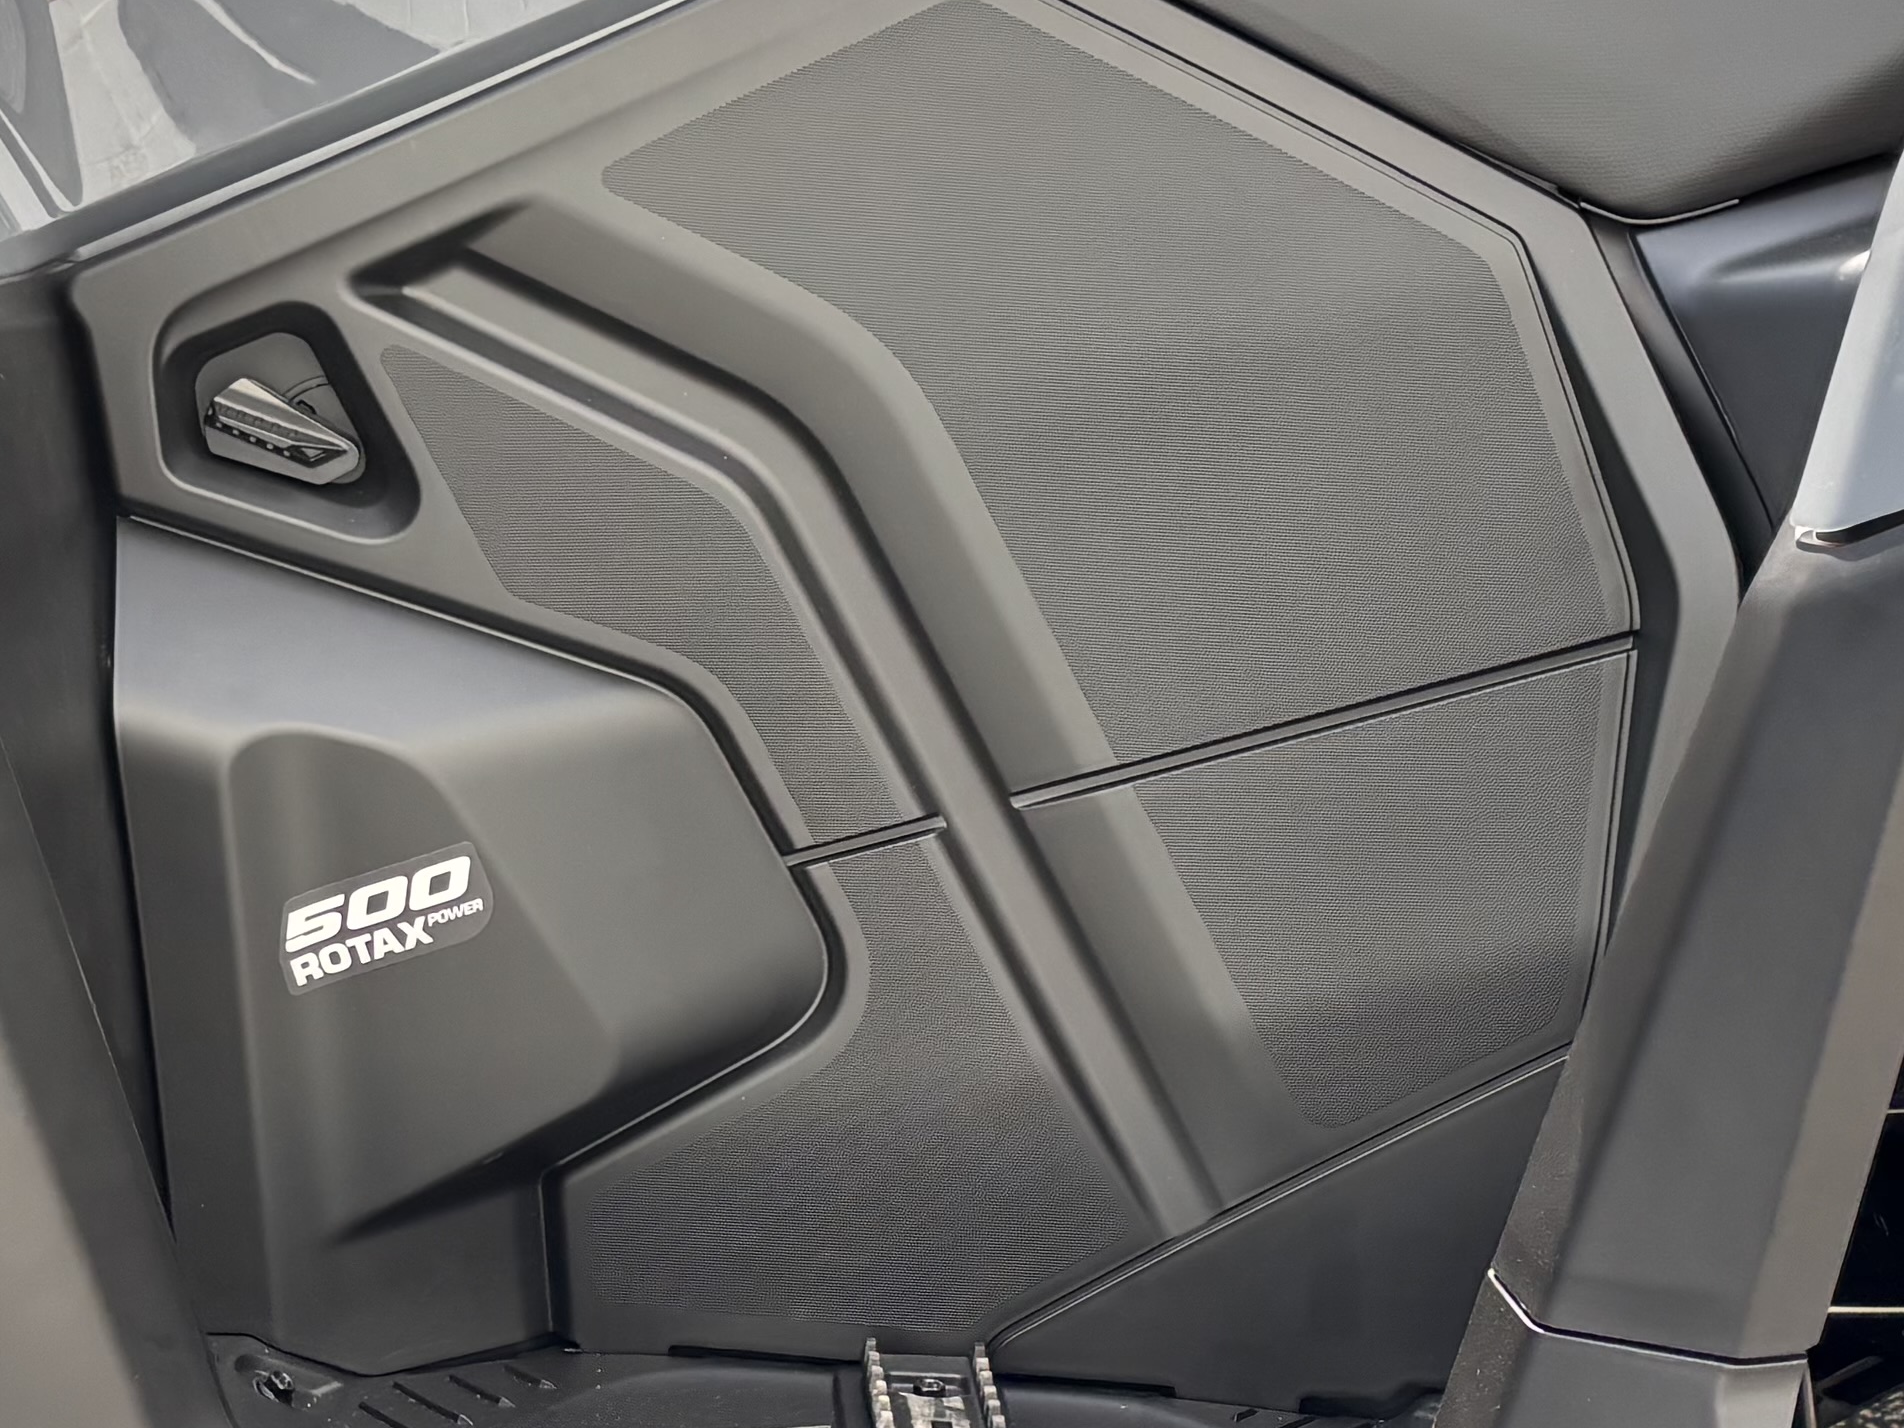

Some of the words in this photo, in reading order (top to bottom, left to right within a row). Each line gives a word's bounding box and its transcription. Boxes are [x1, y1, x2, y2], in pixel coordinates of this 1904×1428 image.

[285, 855, 471, 953] 500
[289, 915, 434, 987] ROTAX
[427, 897, 484, 927] POWER
